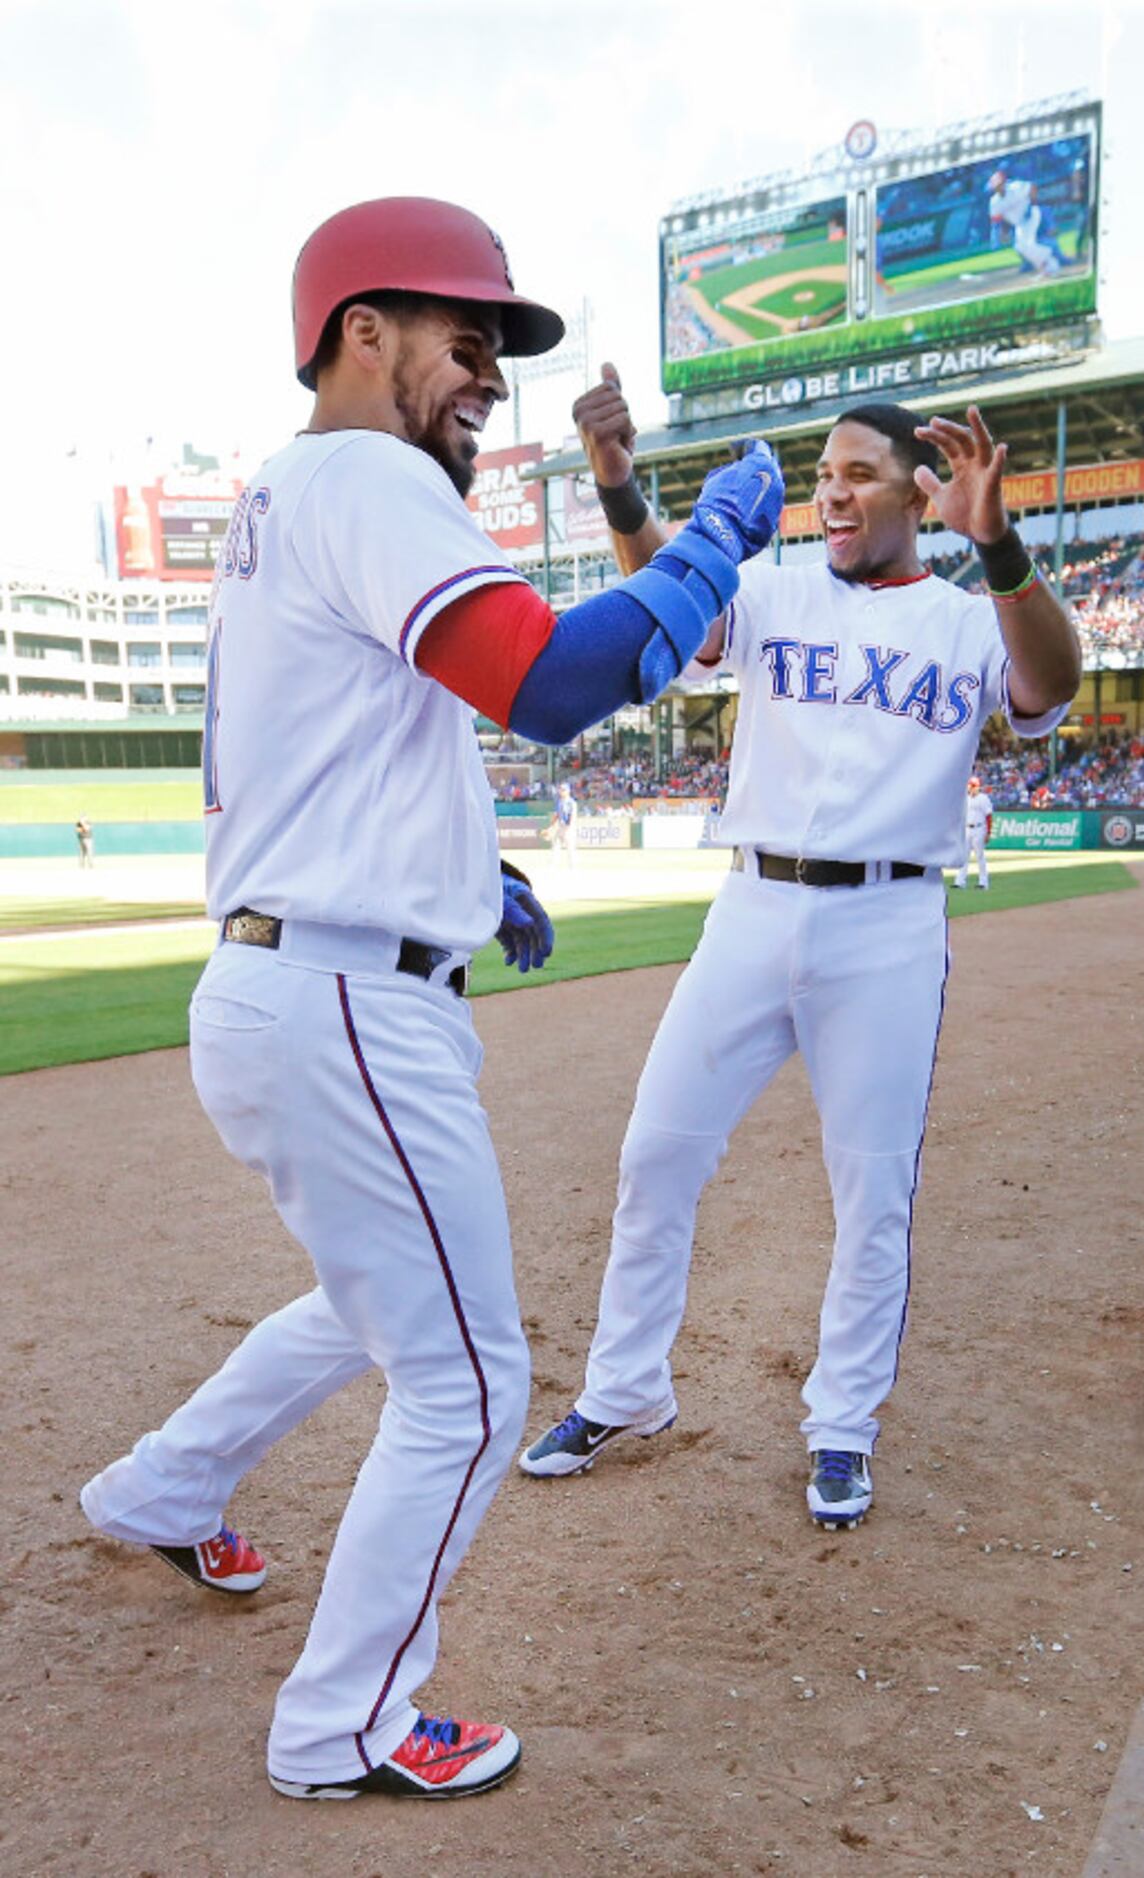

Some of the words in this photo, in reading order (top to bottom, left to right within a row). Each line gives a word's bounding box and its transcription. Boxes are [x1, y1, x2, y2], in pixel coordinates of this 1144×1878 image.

[744, 372, 840, 409] GLOBE
[848, 361, 911, 390] LIFE
[918, 344, 999, 378] PARK
[478, 487, 525, 508] SOME
[758, 637, 979, 733] TEXAS
[576, 820, 621, 845] apple
